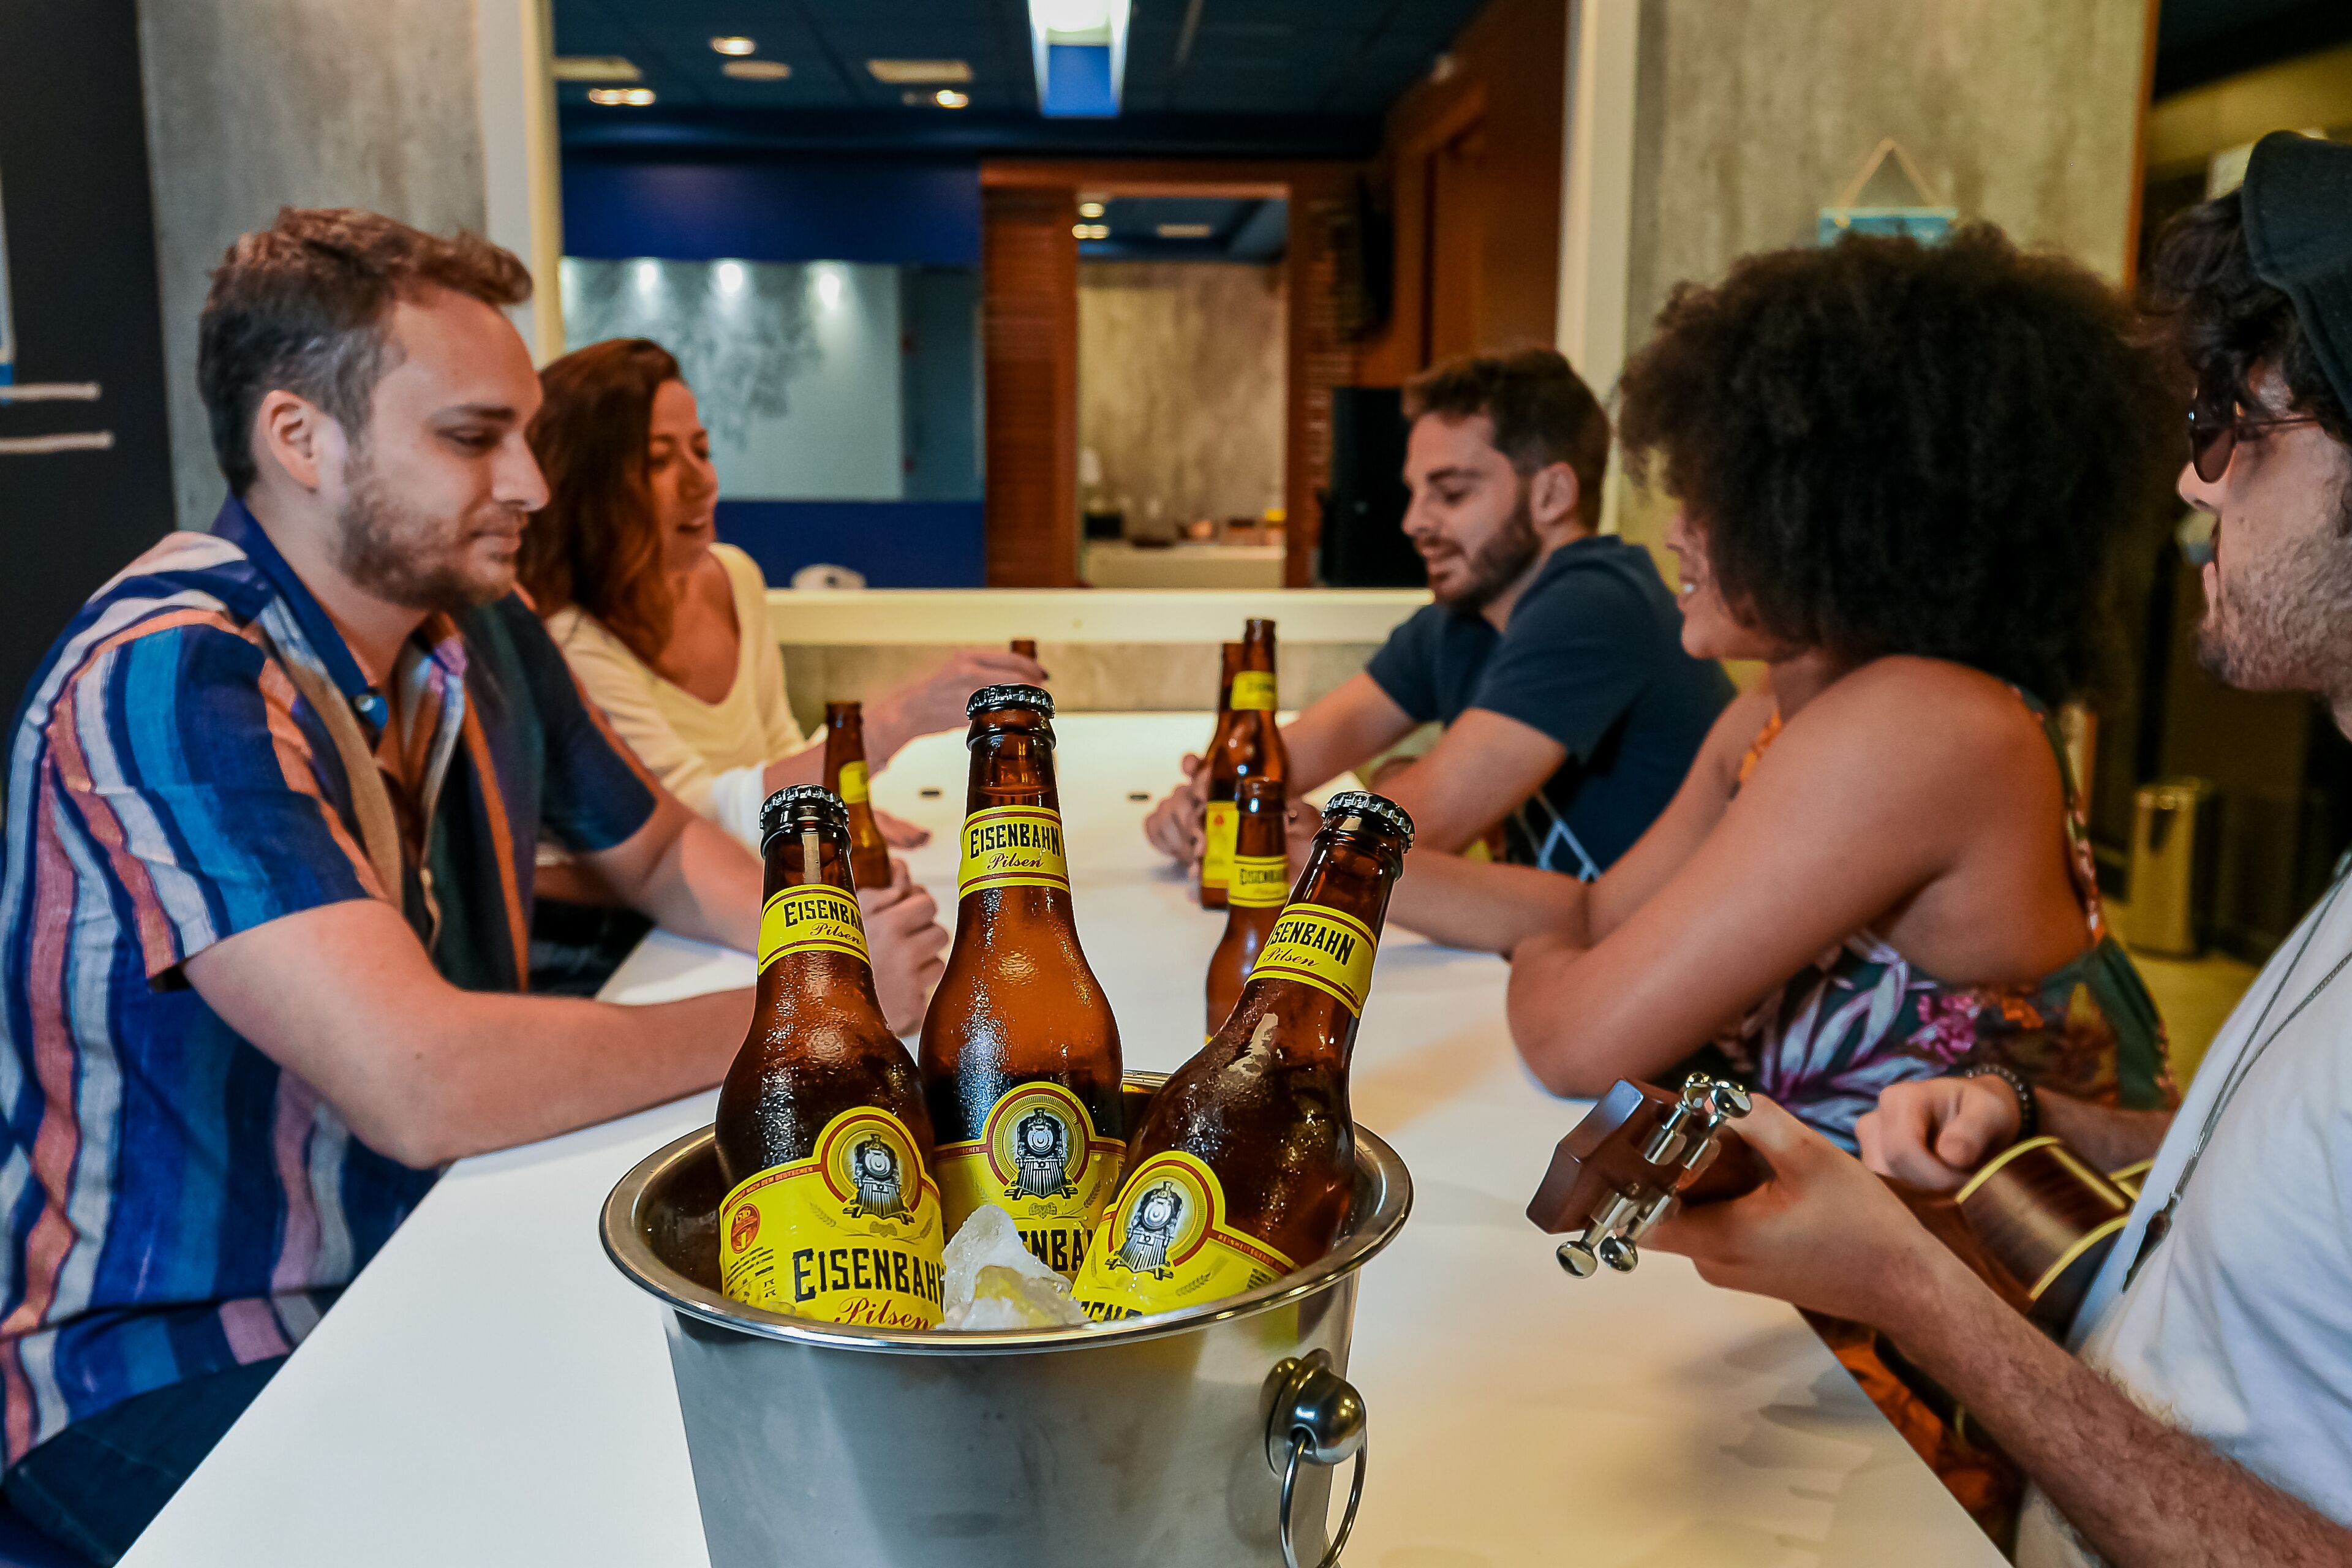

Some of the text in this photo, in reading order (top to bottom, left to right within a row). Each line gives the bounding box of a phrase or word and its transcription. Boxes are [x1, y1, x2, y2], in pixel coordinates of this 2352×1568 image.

[970, 823, 1061, 859] EISENBAHN
[987, 852, 1044, 870] Pilsen
[810, 922, 862, 945] Pilsen
[1266, 921, 1356, 966] ISENBAHN
[1262, 947, 1320, 967] Pilsen
[834, 1295, 936, 1330] Pilsen
